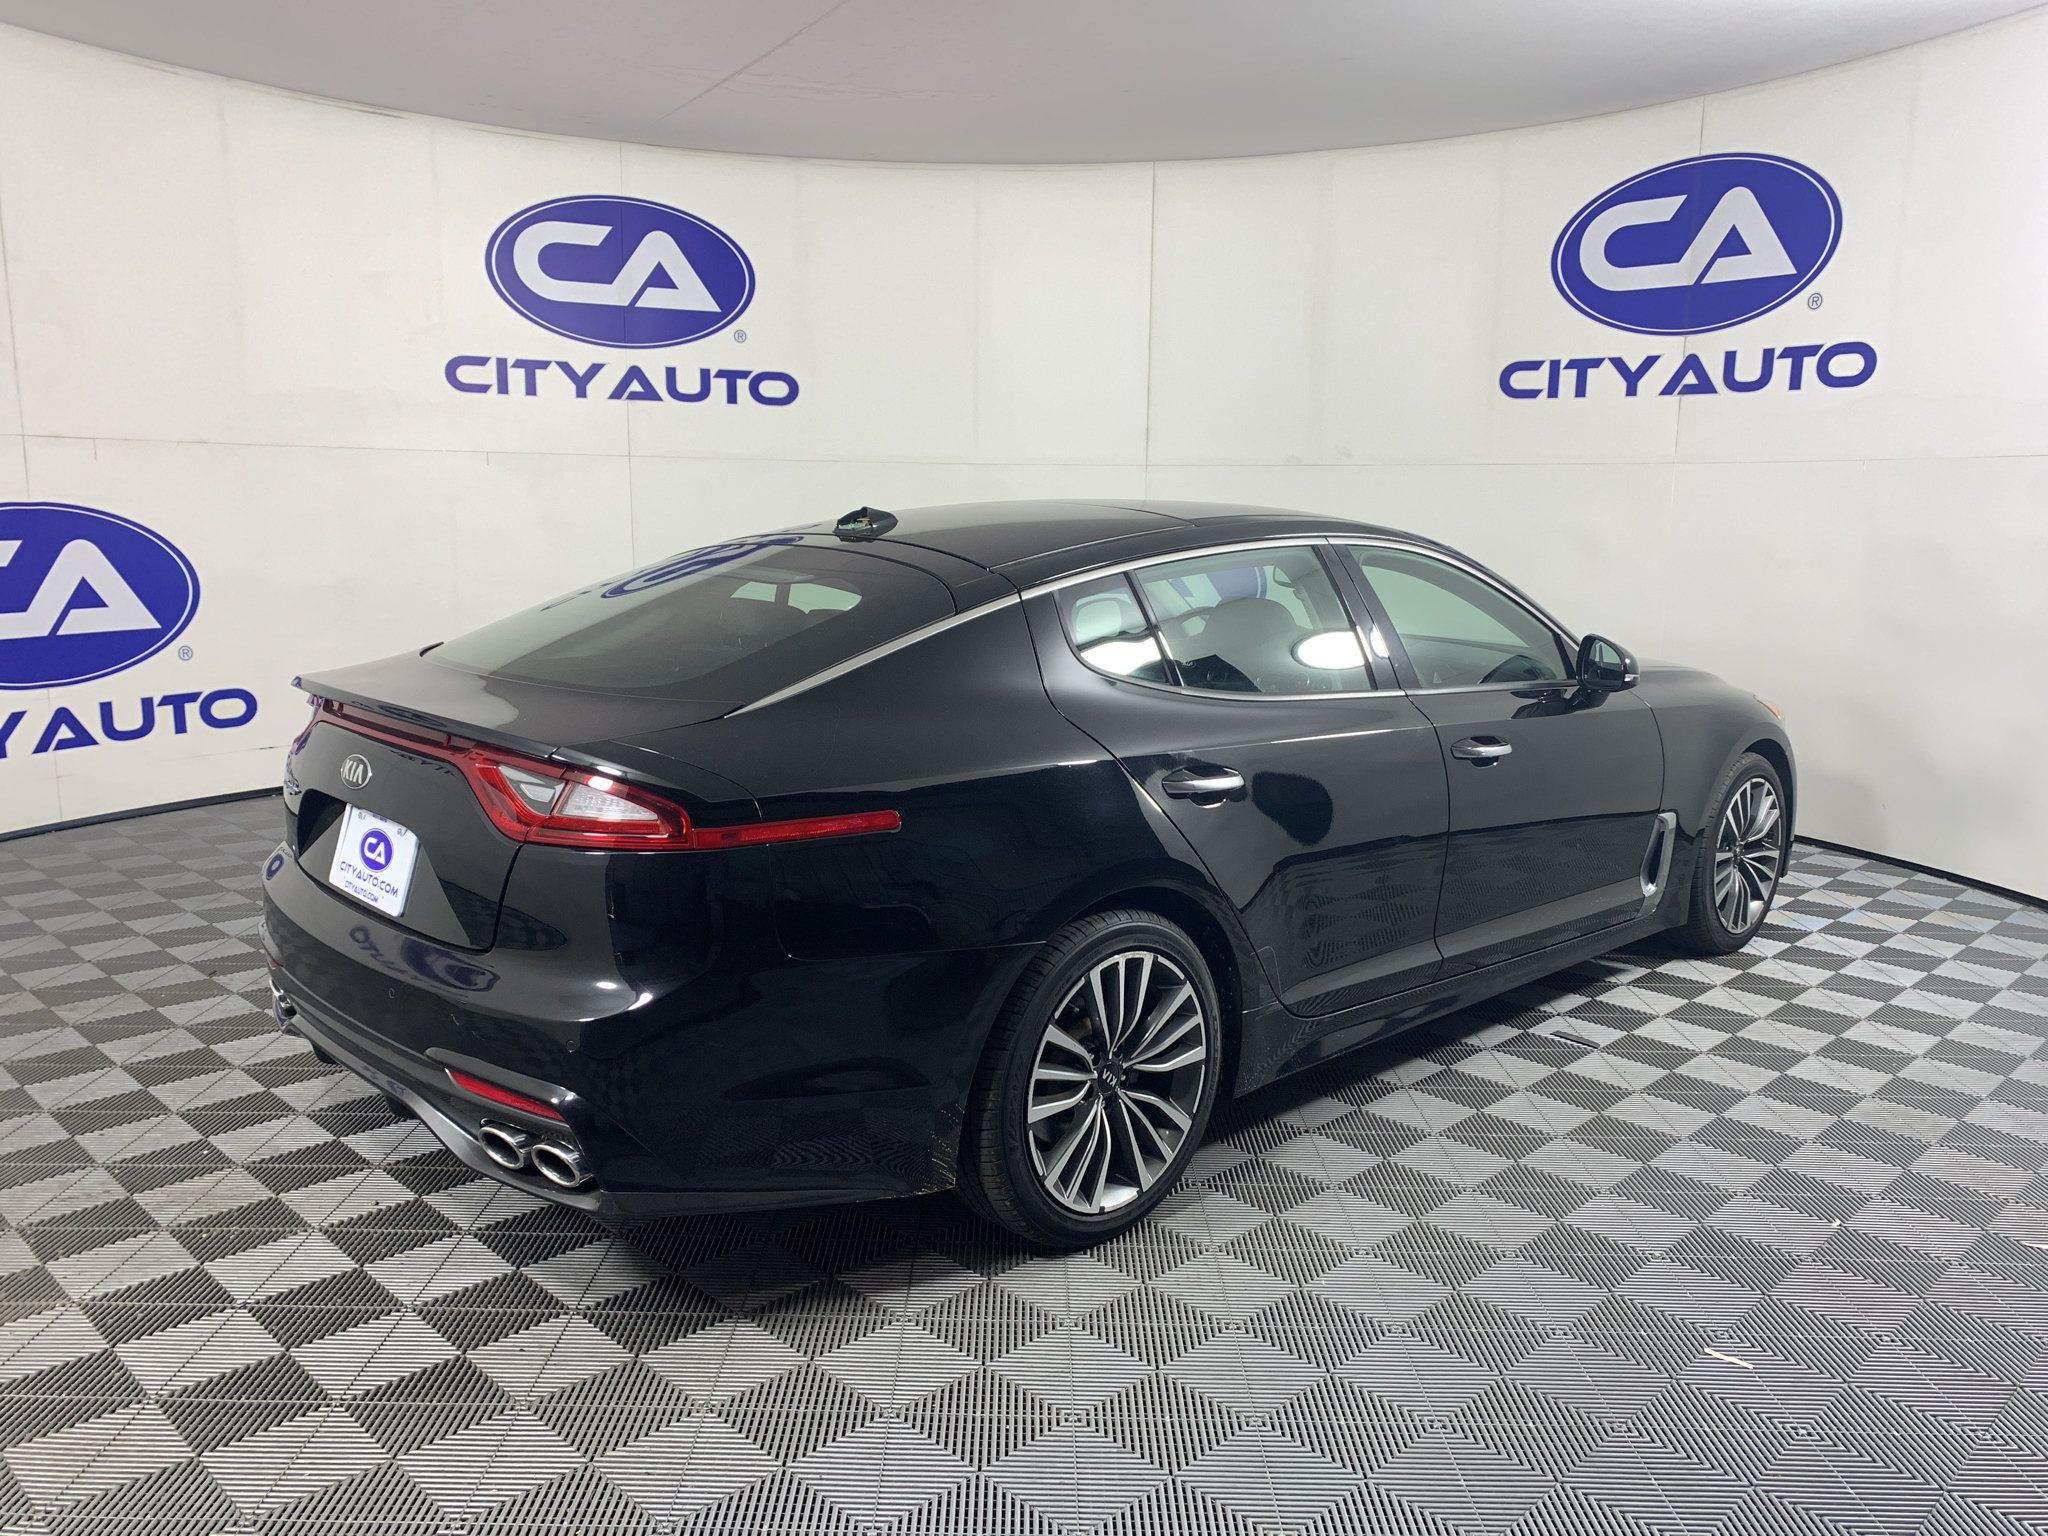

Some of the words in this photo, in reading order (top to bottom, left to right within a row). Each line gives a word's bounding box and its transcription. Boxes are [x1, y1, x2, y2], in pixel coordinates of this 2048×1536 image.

[1579, 186, 1797, 291] CA
[513, 221, 722, 312] CA
[342, 759, 363, 784] KIA
[363, 836, 386, 866] CA
[1102, 1068, 1118, 1087] KIA
